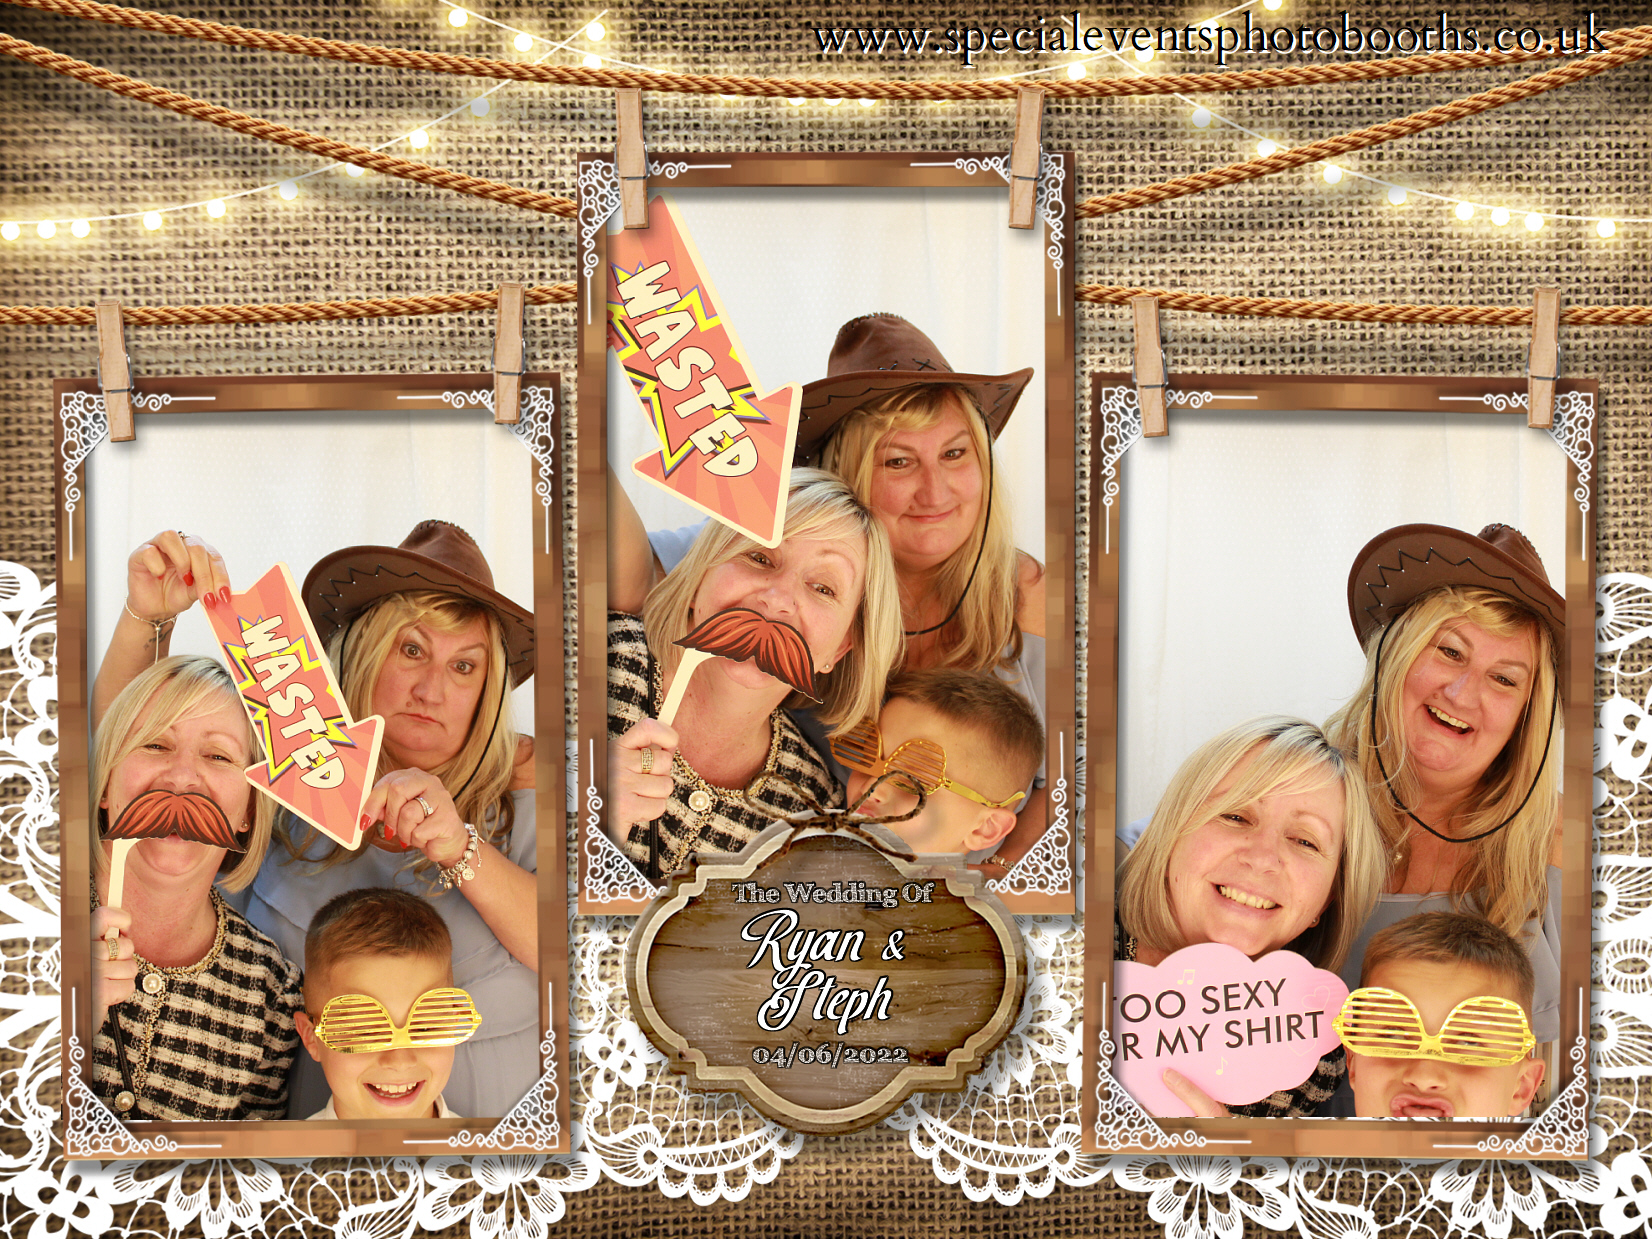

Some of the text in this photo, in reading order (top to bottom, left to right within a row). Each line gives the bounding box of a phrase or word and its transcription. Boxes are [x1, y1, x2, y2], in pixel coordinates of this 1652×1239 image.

[616, 260, 759, 478] WASTED
[240, 614, 346, 790] WASTED
[1113, 978, 1287, 1023] OO SEXY
[1155, 1023, 1211, 1057] MY
[1224, 1010, 1325, 1048] SHIRT
